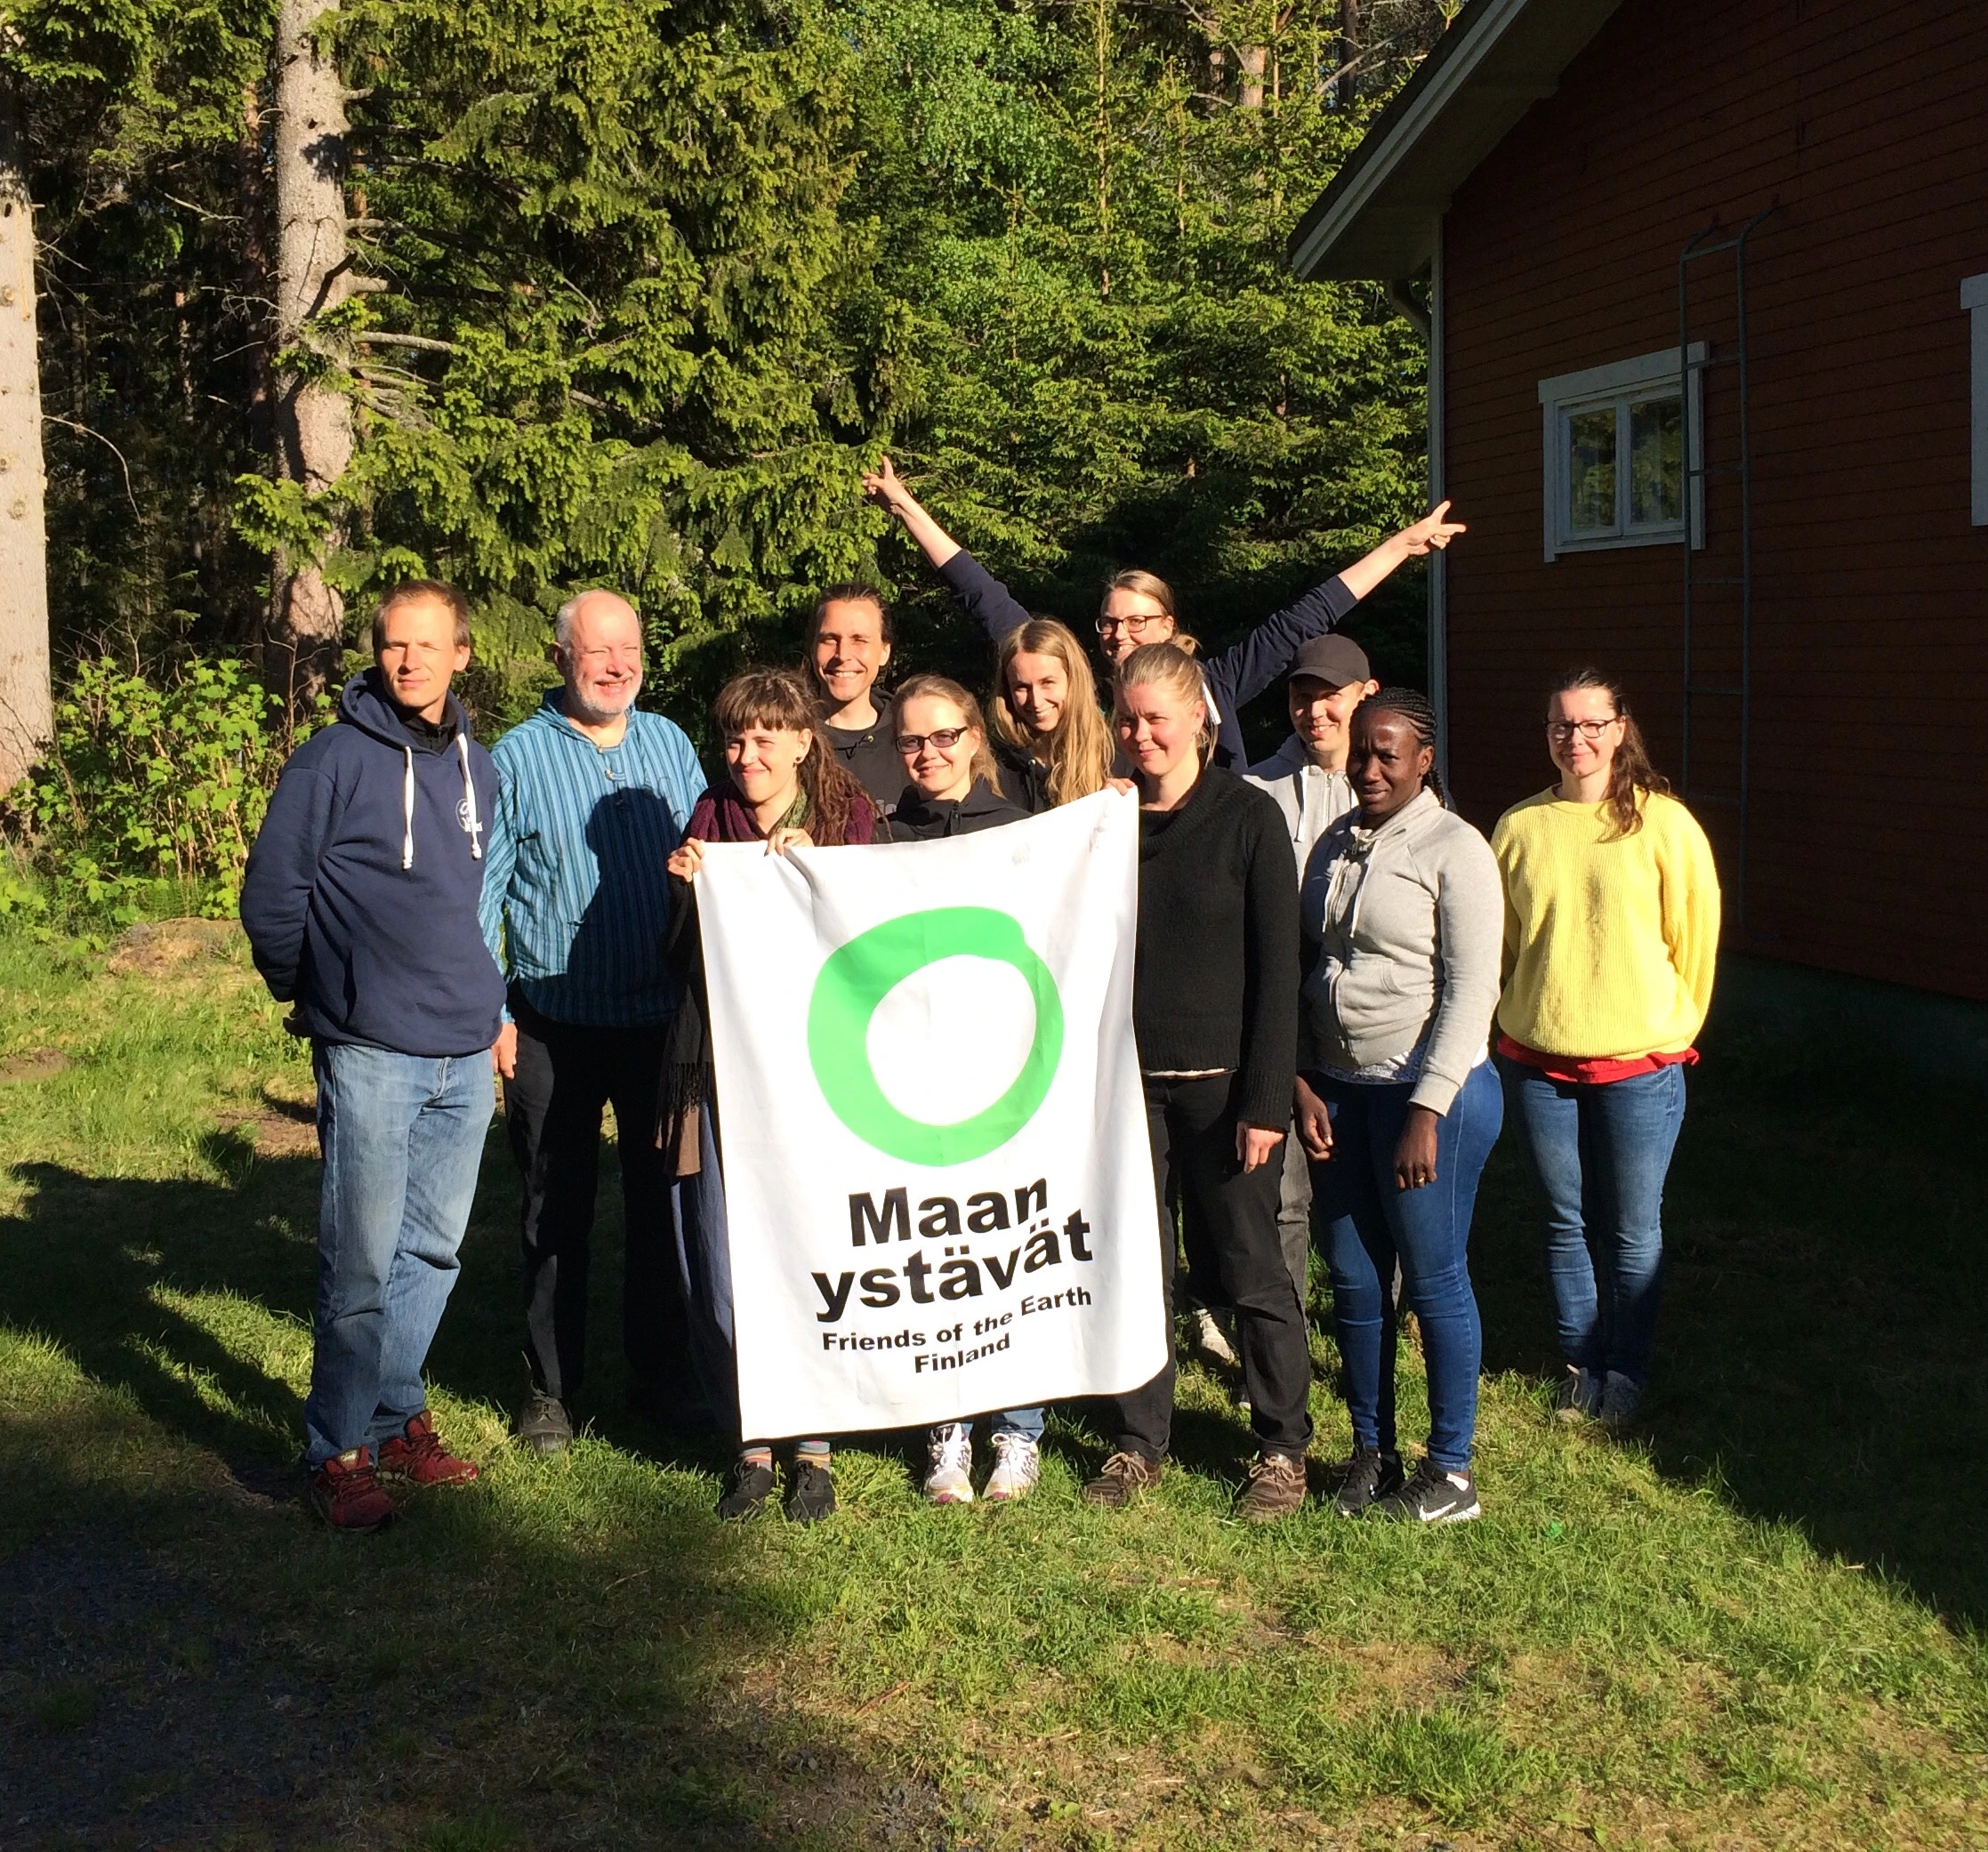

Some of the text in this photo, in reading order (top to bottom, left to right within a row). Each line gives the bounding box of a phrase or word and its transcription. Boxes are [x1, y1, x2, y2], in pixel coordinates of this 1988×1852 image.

[848, 1178, 1048, 1247] Maan
[810, 1208, 1093, 1324] ystävät
[822, 1286, 1092, 1351] Friends of the Earth
[914, 1333, 1010, 1373] Finland
